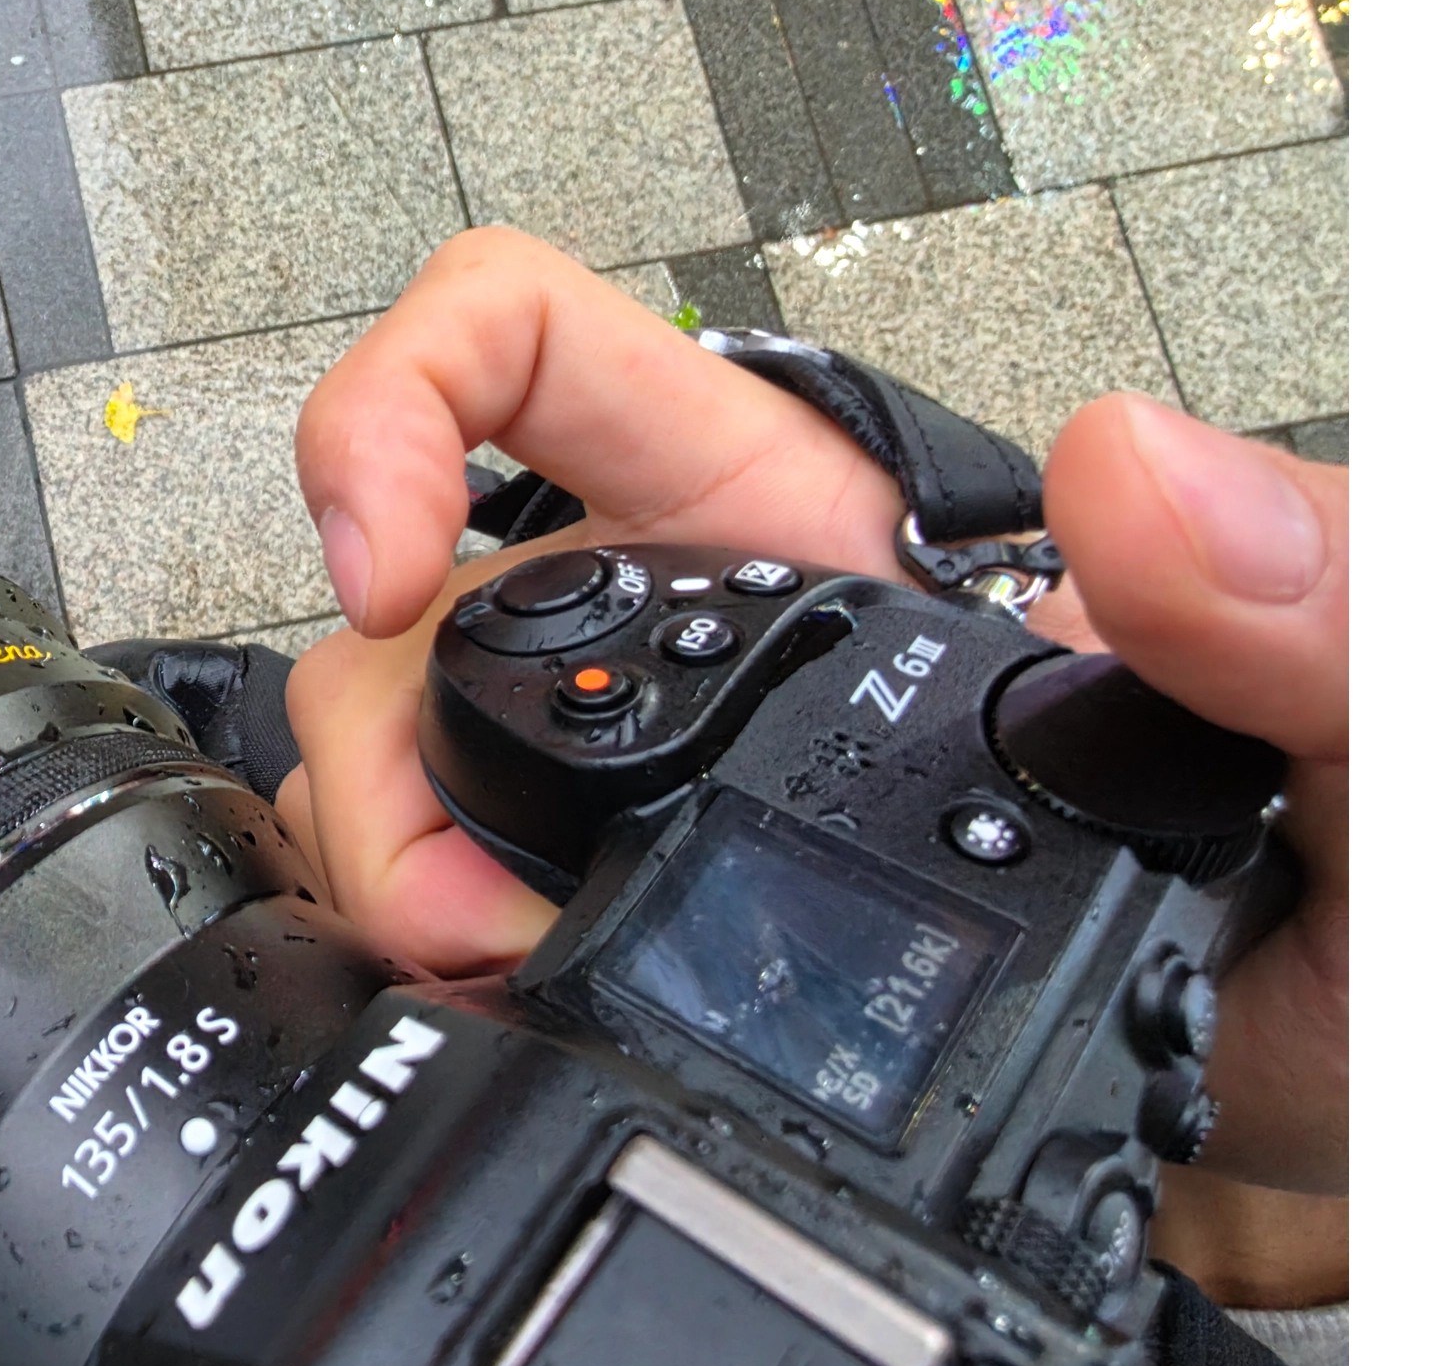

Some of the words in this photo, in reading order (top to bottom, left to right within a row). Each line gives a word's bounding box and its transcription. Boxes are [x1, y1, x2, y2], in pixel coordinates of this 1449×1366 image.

[616, 561, 647, 594] OFF
[675, 618, 719, 651] ISO
[47, 1005, 162, 1124] NIKKOR
[60, 1031, 213, 1200] 135/1.8
[194, 1005, 241, 1046] S
[841, 1070, 882, 1111] SD
[174, 1015, 446, 1330] Nikon
